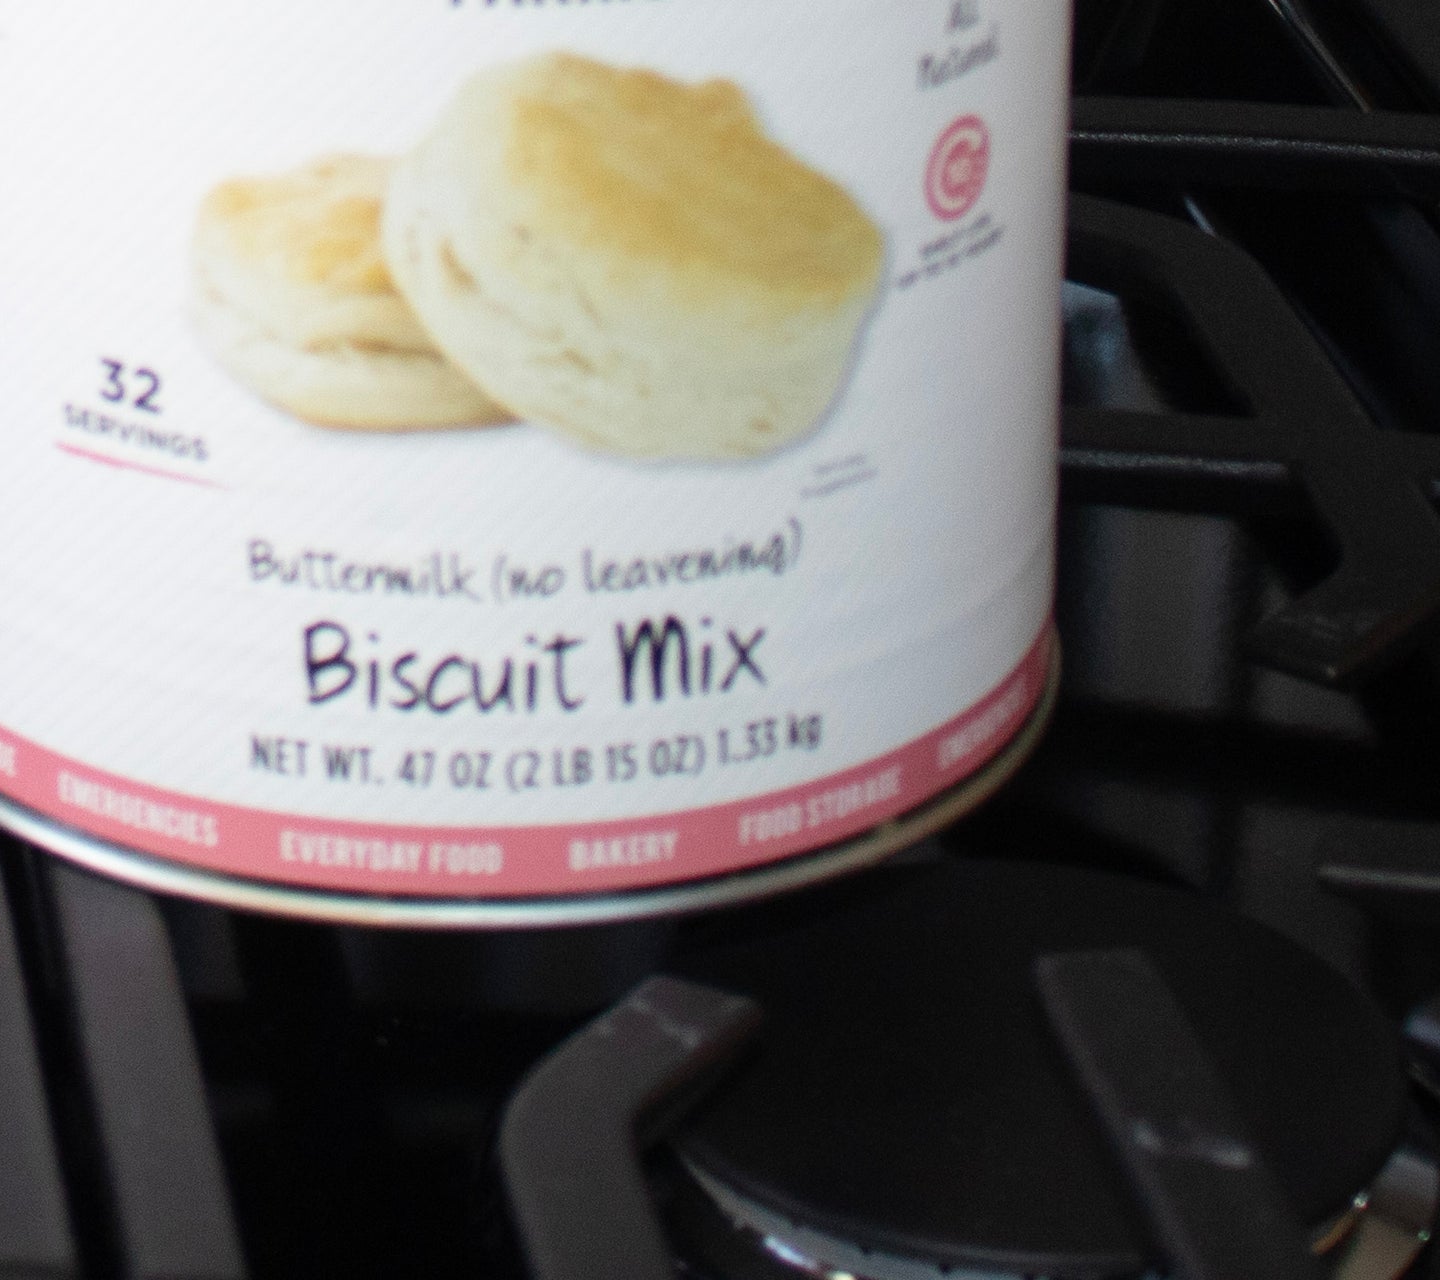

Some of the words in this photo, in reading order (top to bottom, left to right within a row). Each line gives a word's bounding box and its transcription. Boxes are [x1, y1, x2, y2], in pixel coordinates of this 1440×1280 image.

[100, 356, 162, 414] 32
[64, 403, 209, 461] SERVINGS
[246, 538, 482, 602] Buttermilk
[491, 552, 566, 604] (no
[582, 515, 804, 593] leavening)
[303, 618, 584, 714] Biscuit
[616, 613, 767, 704] Mix
[250, 734, 310, 779] NET
[322, 744, 385, 786] WT.
[397, 748, 436, 786] 47
[449, 751, 490, 789] OZ
[505, 748, 542, 793] (2
[553, 746, 592, 786] LB
[606, 743, 638, 782] 15
[648, 734, 706, 777] OZ)
[718, 717, 780, 766] 1.33
[57, 770, 219, 847] EMERGENCIES
[737, 803, 804, 847] FOOD
[806, 764, 903, 828] STORAGE
[279, 830, 420, 873] EVERYDAY
[429, 842, 504, 876] FOOD
[568, 830, 680, 872] BAKERY
